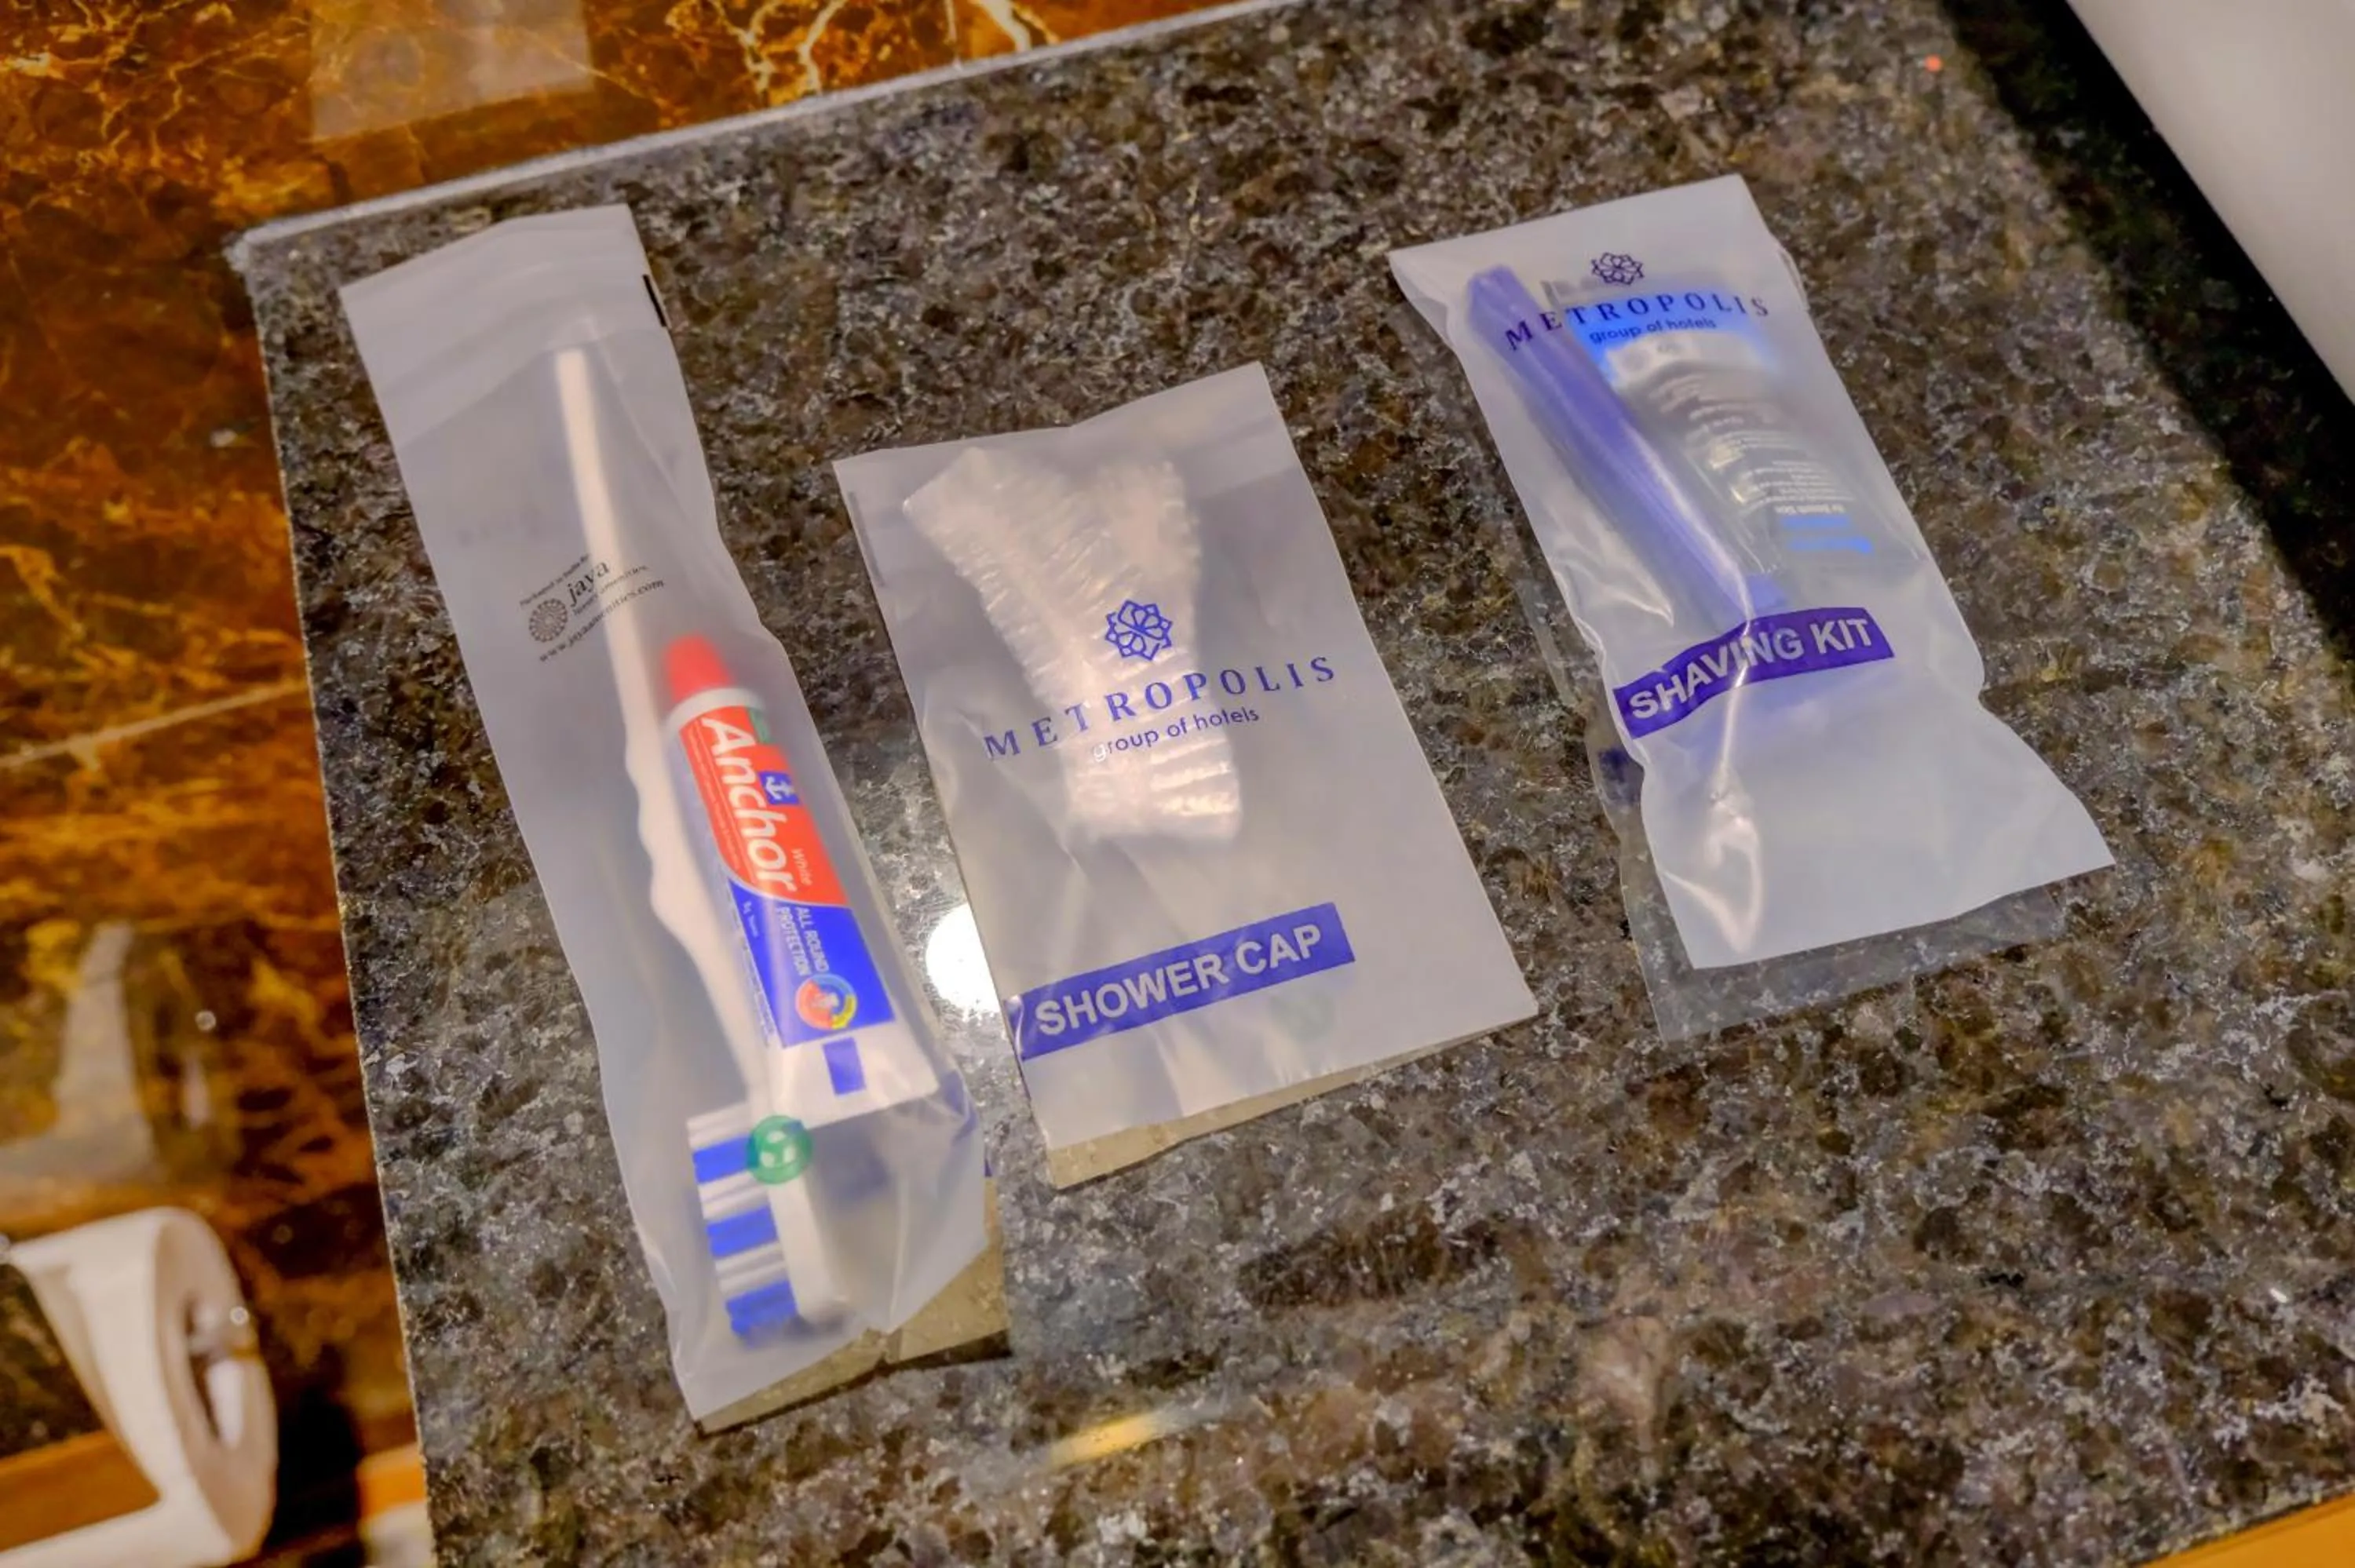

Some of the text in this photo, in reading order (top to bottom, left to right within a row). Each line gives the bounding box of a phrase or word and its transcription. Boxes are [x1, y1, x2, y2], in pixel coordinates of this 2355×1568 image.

[1505, 292, 1769, 352] METROPOLIS
[1589, 317, 1717, 345] group of hotels
[567, 561, 610, 607] jaya
[1628, 618, 1874, 720] SHAVING KIT
[983, 655, 1335, 760] METROPOLIS
[1094, 706, 1260, 762] group of hotels
[700, 717, 798, 893] Anchor
[776, 906, 812, 976] PROTECTION
[795, 906, 830, 972] ALL ROUND
[1035, 924, 1322, 1036] SHOWER CAP
